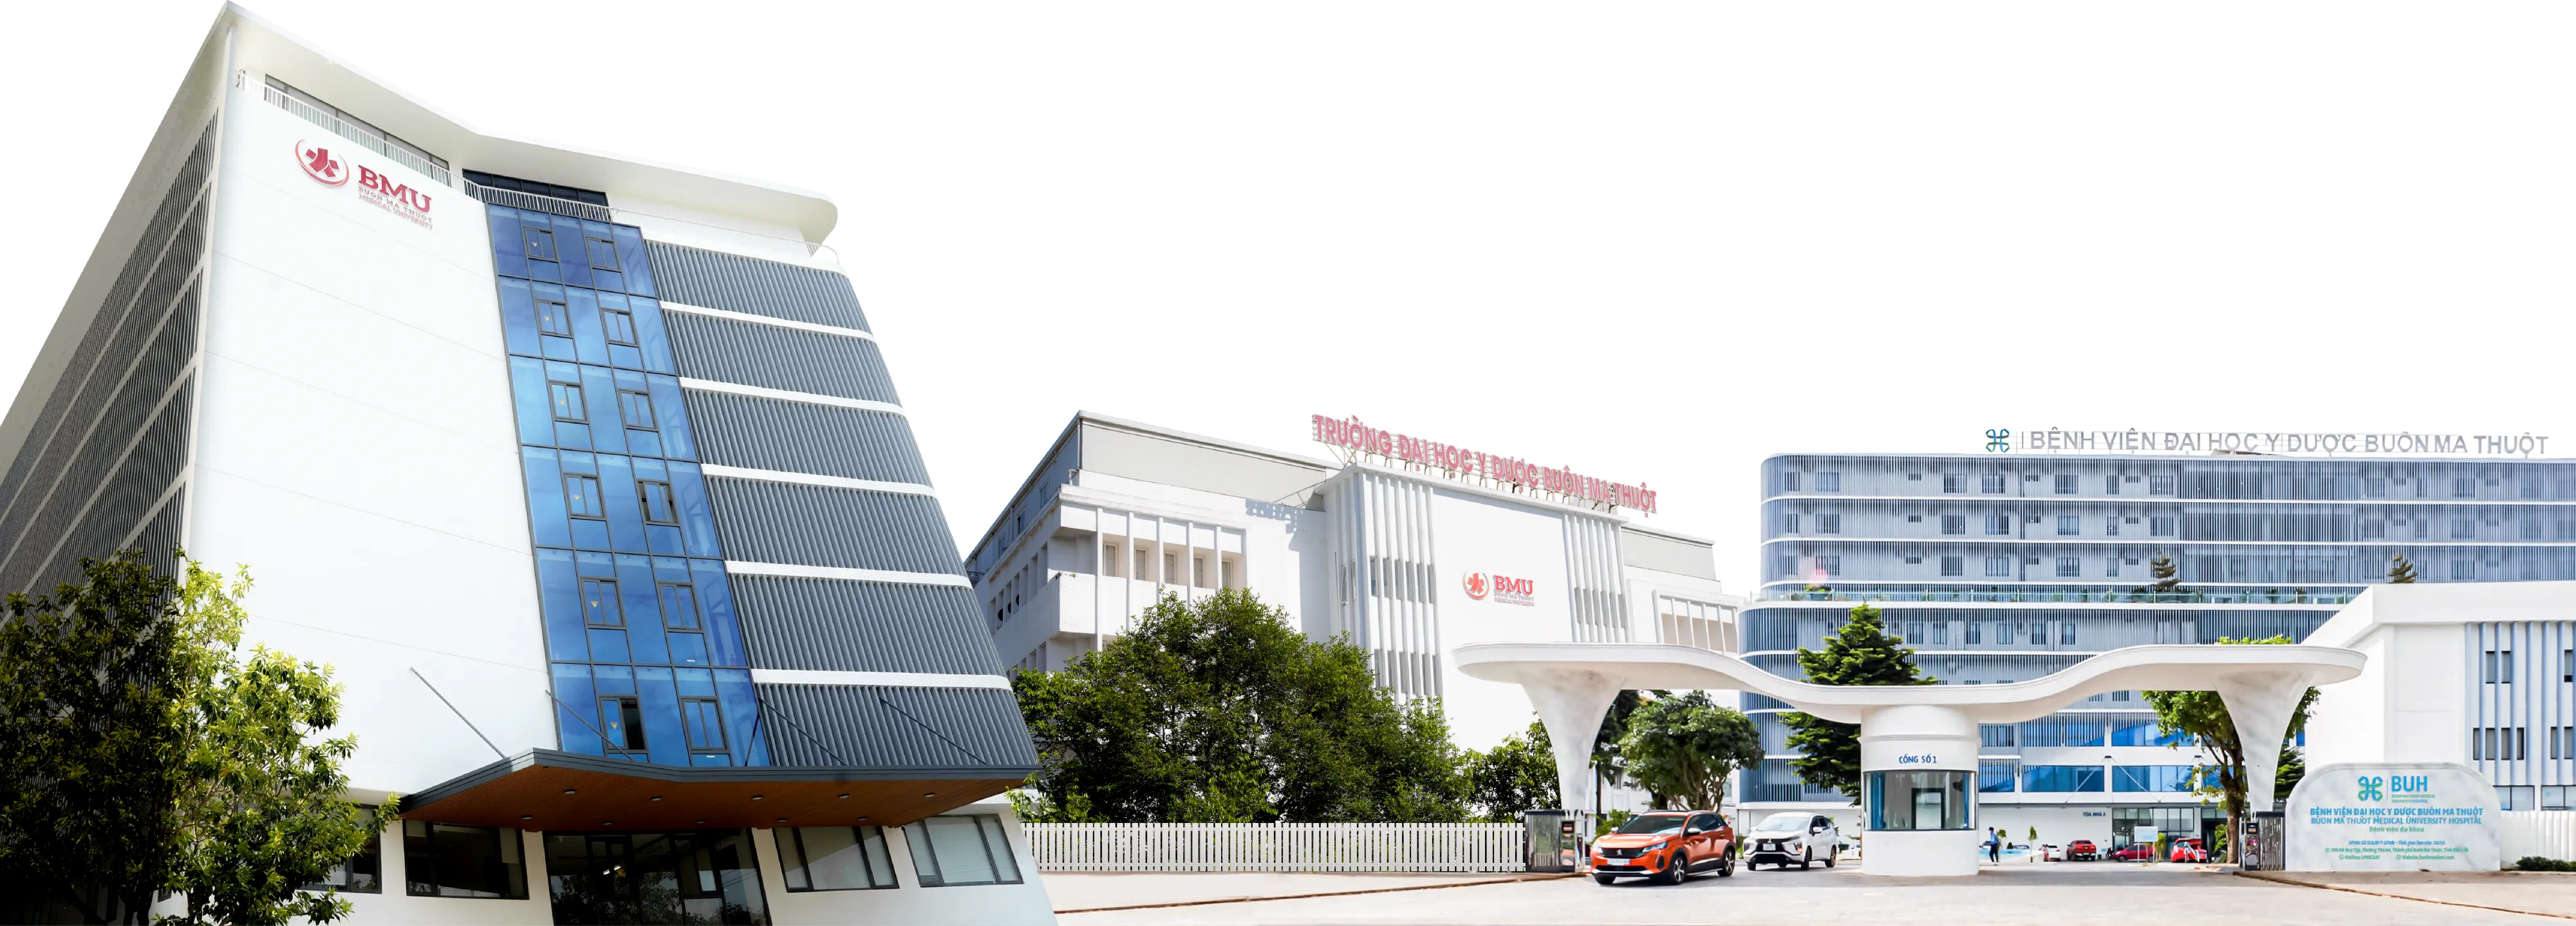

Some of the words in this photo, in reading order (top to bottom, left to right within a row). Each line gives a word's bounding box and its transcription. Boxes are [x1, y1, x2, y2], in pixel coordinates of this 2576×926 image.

[358, 165, 431, 213] BMU
[359, 186, 382, 200] BUON
[387, 199, 400, 208] MA
[359, 193, 391, 211] MEDICAL
[393, 208, 433, 230] UNIVERSITY
[2264, 433, 2279, 451] Y
[2288, 433, 2357, 457] DƯỢC
[2365, 431, 2429, 452] BUÔN
[2434, 435, 2468, 453] MA
[2474, 432, 2549, 458] THUỘT
[1313, 414, 1392, 455] TRƯỜNG
[1398, 434, 1429, 471] ĐẠI
[1433, 442, 1473, 478] HỌC
[1476, 451, 1486, 476] Y
[1491, 456, 1539, 493] DƯỢC
[1543, 465, 1585, 497] BUÔN
[1588, 477, 1611, 502] MA
[1612, 482, 1657, 518] THUỘT
[1493, 574, 1533, 595] BMU
[2391, 775, 2428, 792] BUH
[2310, 806, 2331, 817] BỆNH
